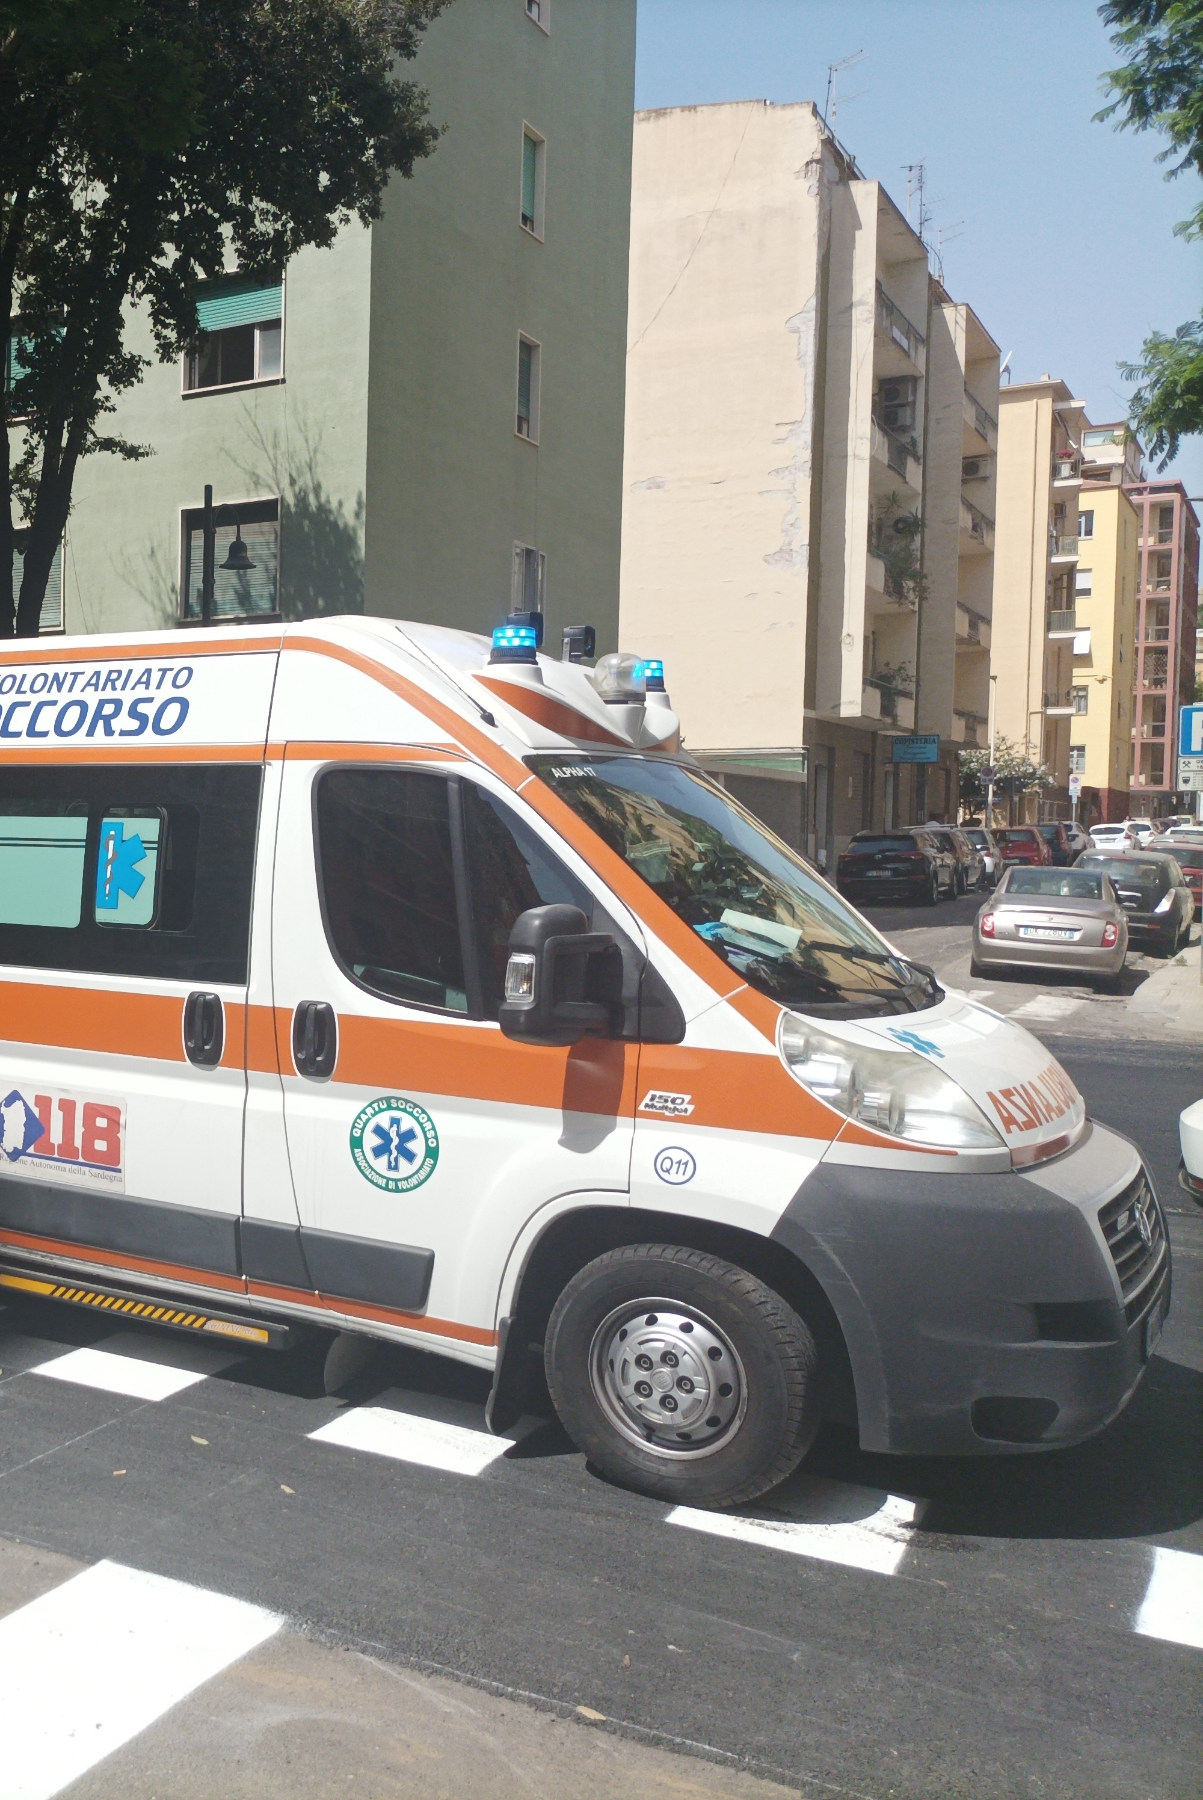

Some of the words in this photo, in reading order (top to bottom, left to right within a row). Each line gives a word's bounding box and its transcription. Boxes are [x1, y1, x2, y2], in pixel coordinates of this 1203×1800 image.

[894, 737, 936, 745] COPISTERIA
[551, 766, 587, 778] ALPHA
[584, 766, 597, 777] 17
[649, 1094, 685, 1105] 150
[33, 1094, 122, 1167] 118
[352, 1099, 387, 1137] QUARTU
[391, 1098, 437, 1148] SOCCORSO
[29, 1159, 67, 1173] Autonoma
[68, 1164, 86, 1176] della
[88, 1169, 123, 1183] Sardegna
[353, 1148, 387, 1188] ASSOCIAZIONE
[388, 1181, 395, 1190] DI
[397, 1158, 434, 1190] VOLONTARIATO
[660, 1156, 689, 1176] Q11
